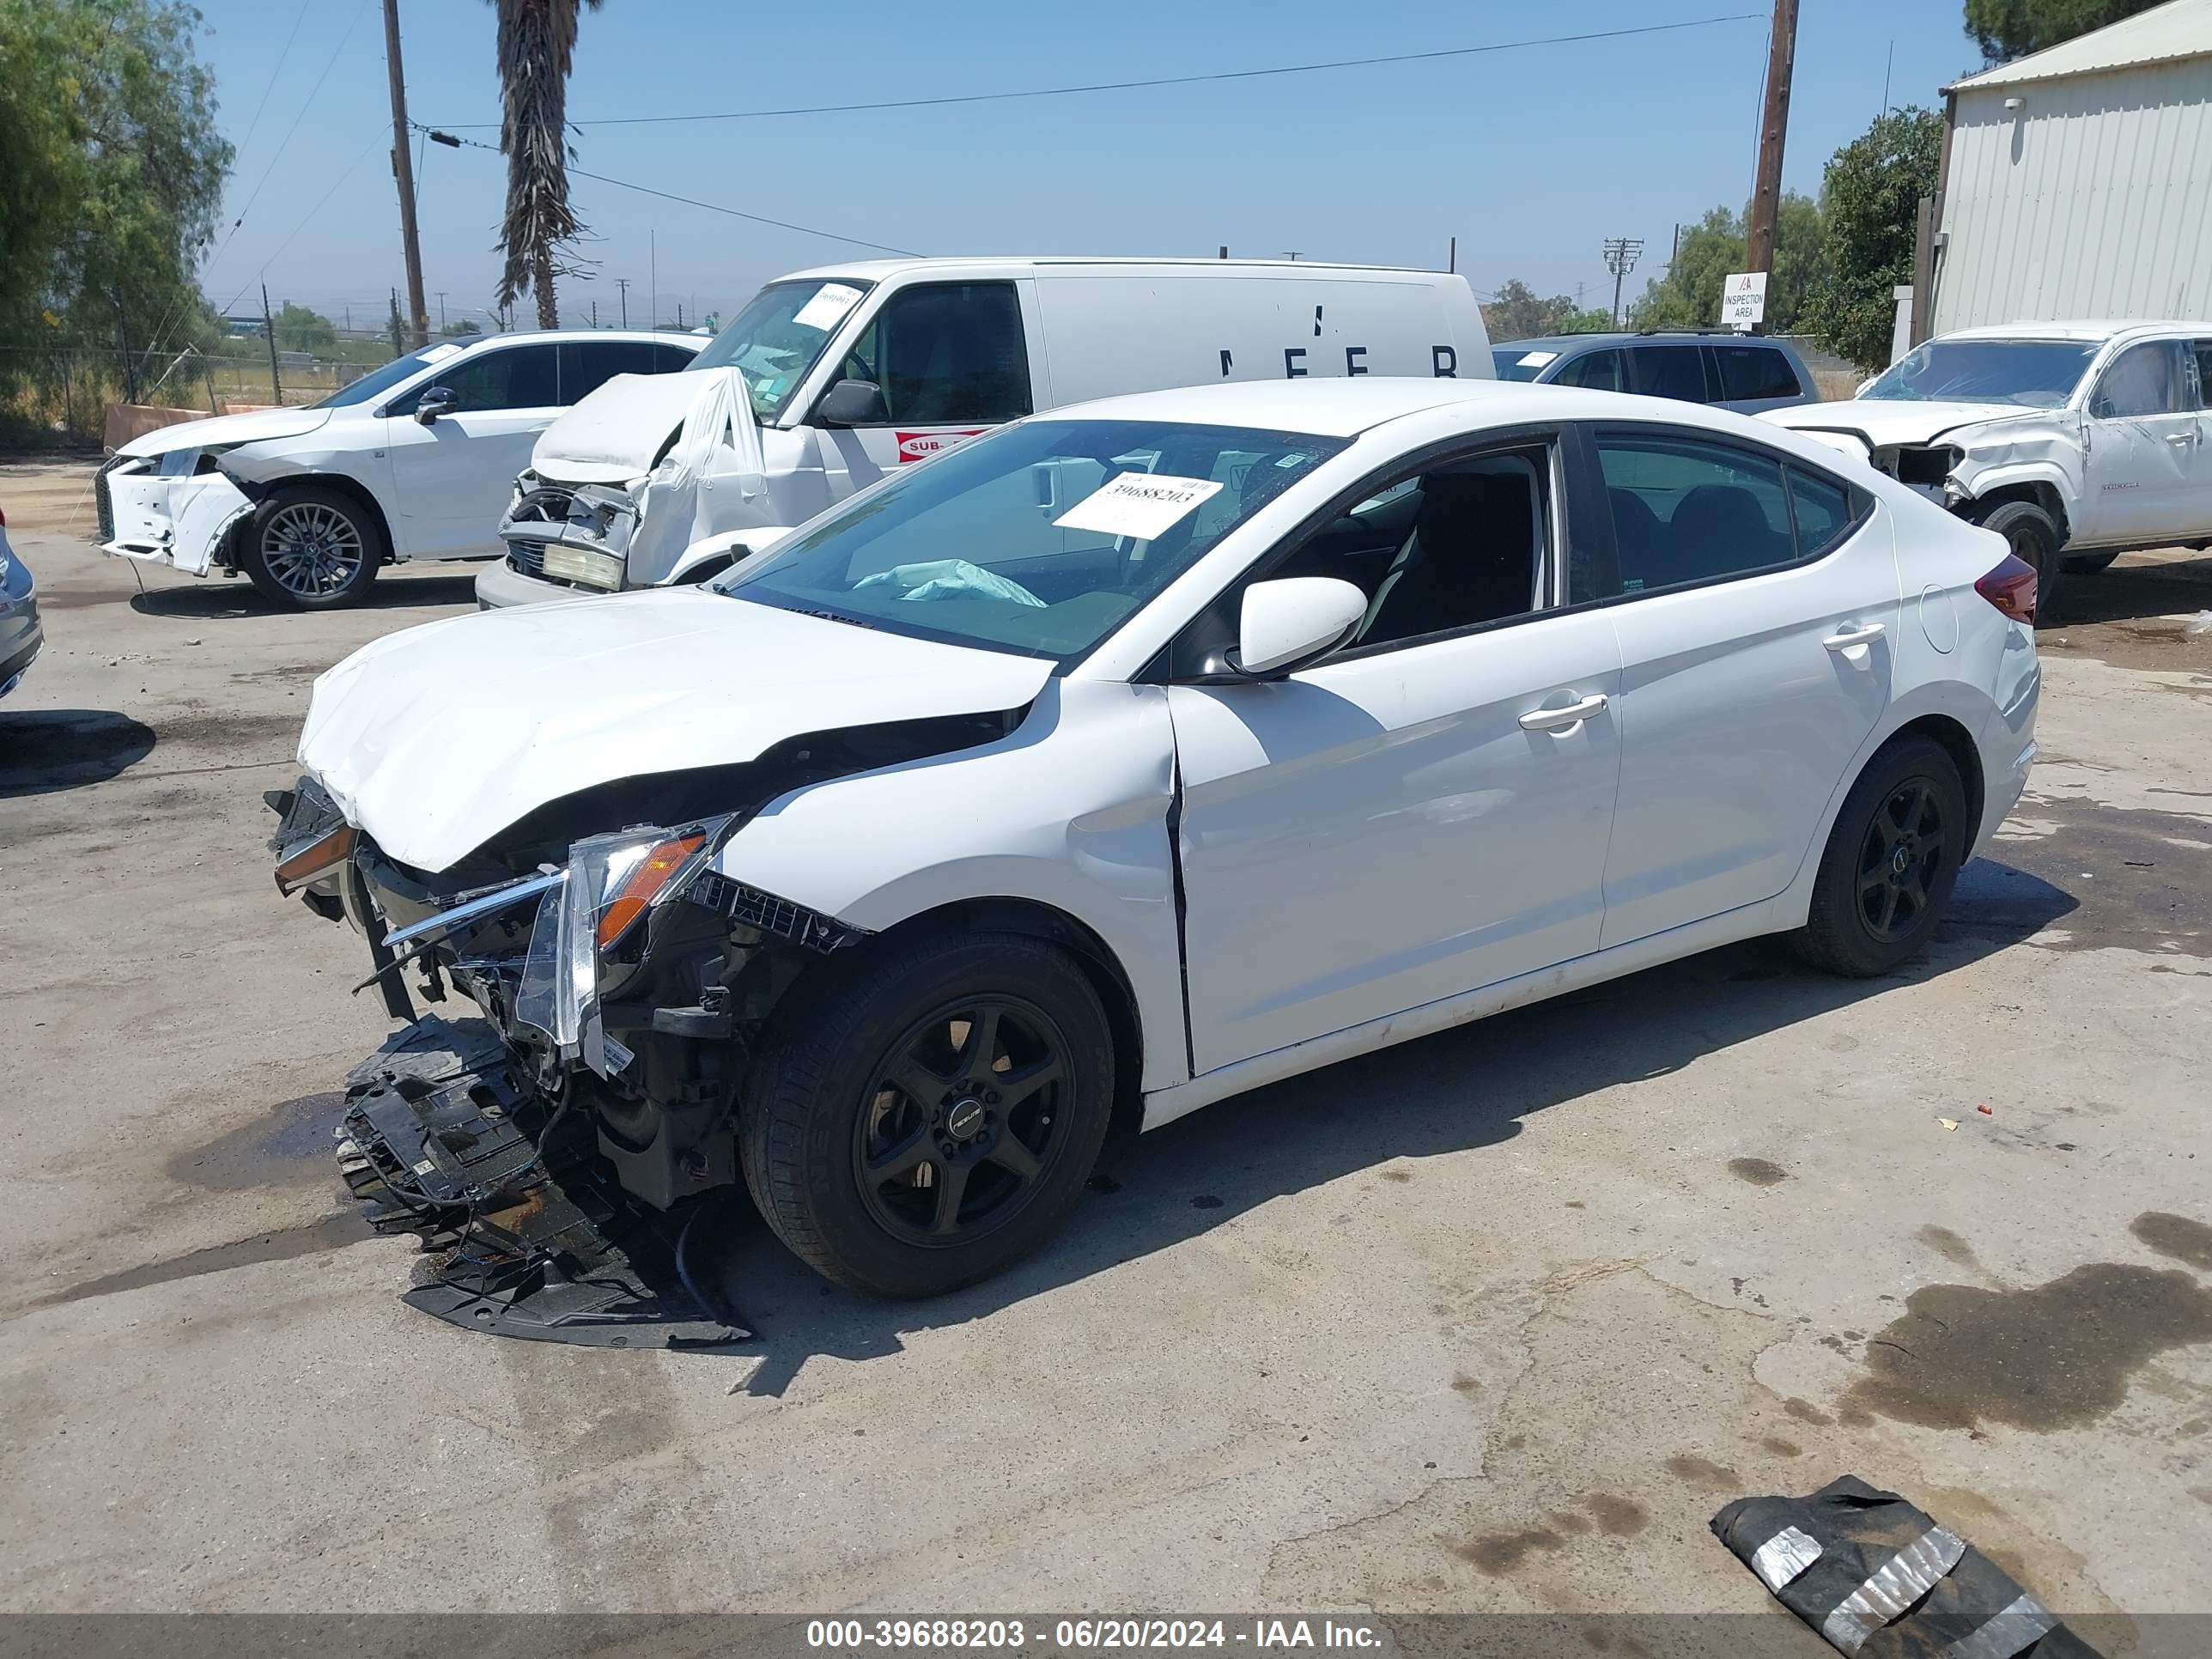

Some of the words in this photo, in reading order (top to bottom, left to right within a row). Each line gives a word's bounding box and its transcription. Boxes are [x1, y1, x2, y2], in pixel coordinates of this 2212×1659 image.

[1725, 293, 1764, 306] INSPECTION
[1734, 307, 1753, 318] AREA
[1108, 484, 1194, 503] 39688203
